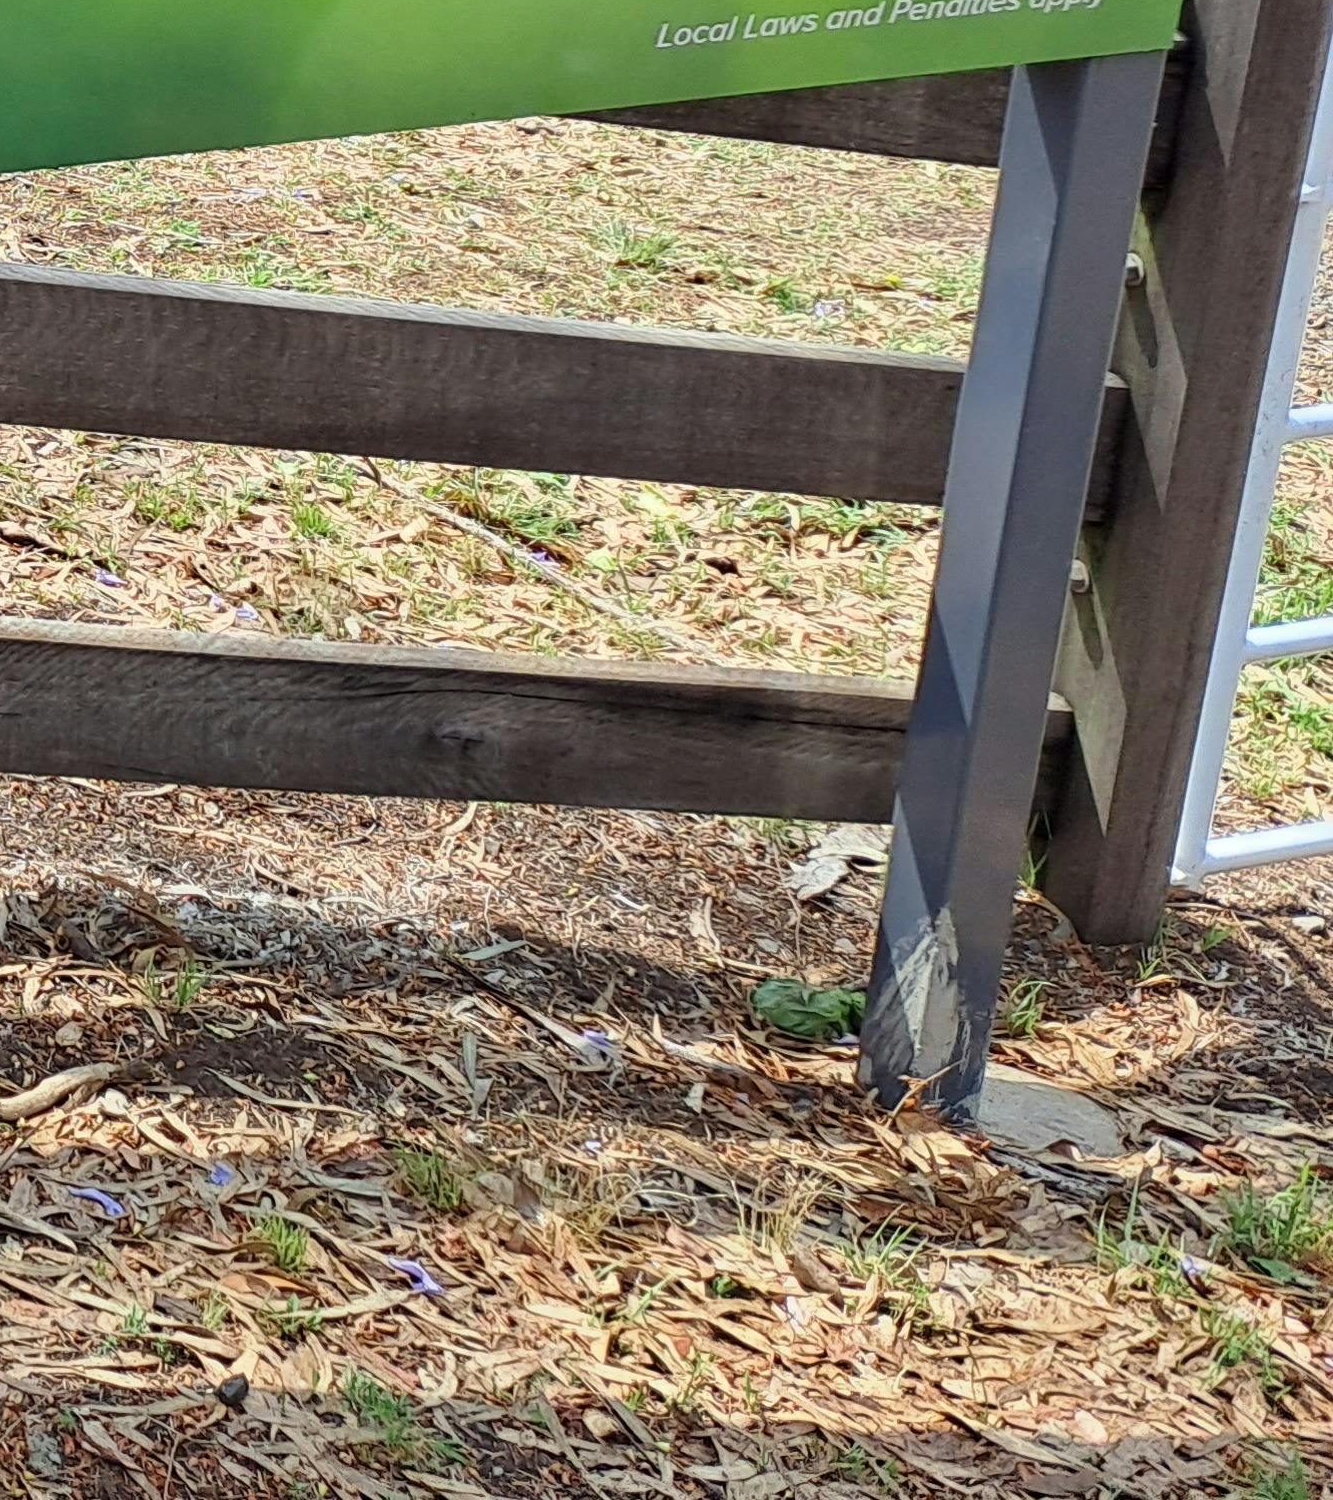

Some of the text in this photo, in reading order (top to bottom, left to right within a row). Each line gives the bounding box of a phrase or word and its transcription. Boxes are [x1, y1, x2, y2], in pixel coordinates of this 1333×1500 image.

[655, 16, 738, 48] Local
[742, 13, 818, 39] Laws
[826, 1, 885, 31] and
